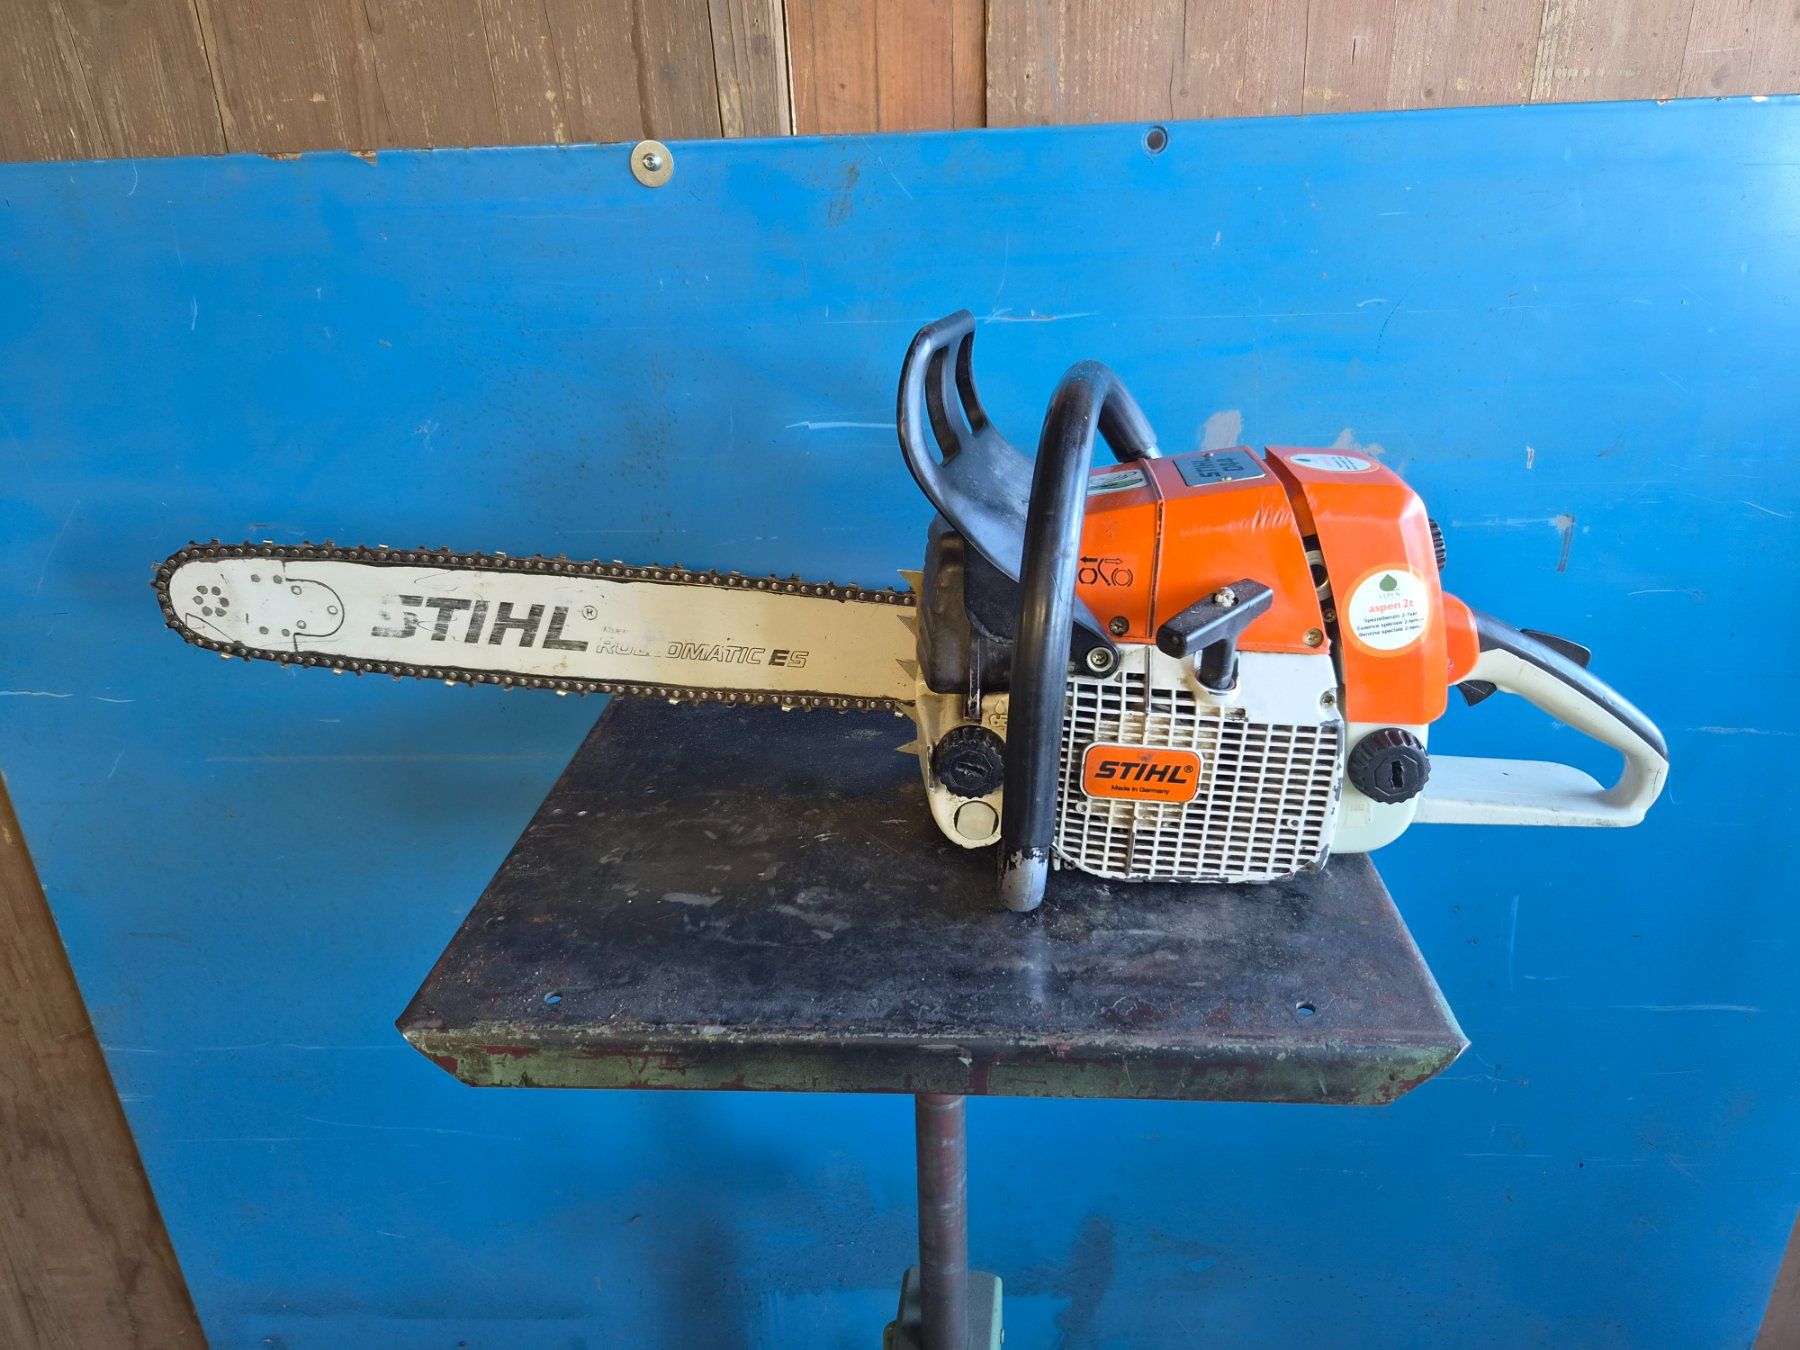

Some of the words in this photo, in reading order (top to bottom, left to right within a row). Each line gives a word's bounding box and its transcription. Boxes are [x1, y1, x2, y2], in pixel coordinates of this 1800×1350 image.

[1368, 602, 1401, 614] aspen
[1402, 599, 1415, 609] 2t
[596, 636, 766, 665] ROOMATIC
[768, 649, 809, 669] ES
[1111, 784, 1131, 792] Made
[1139, 786, 1170, 796] Germany
